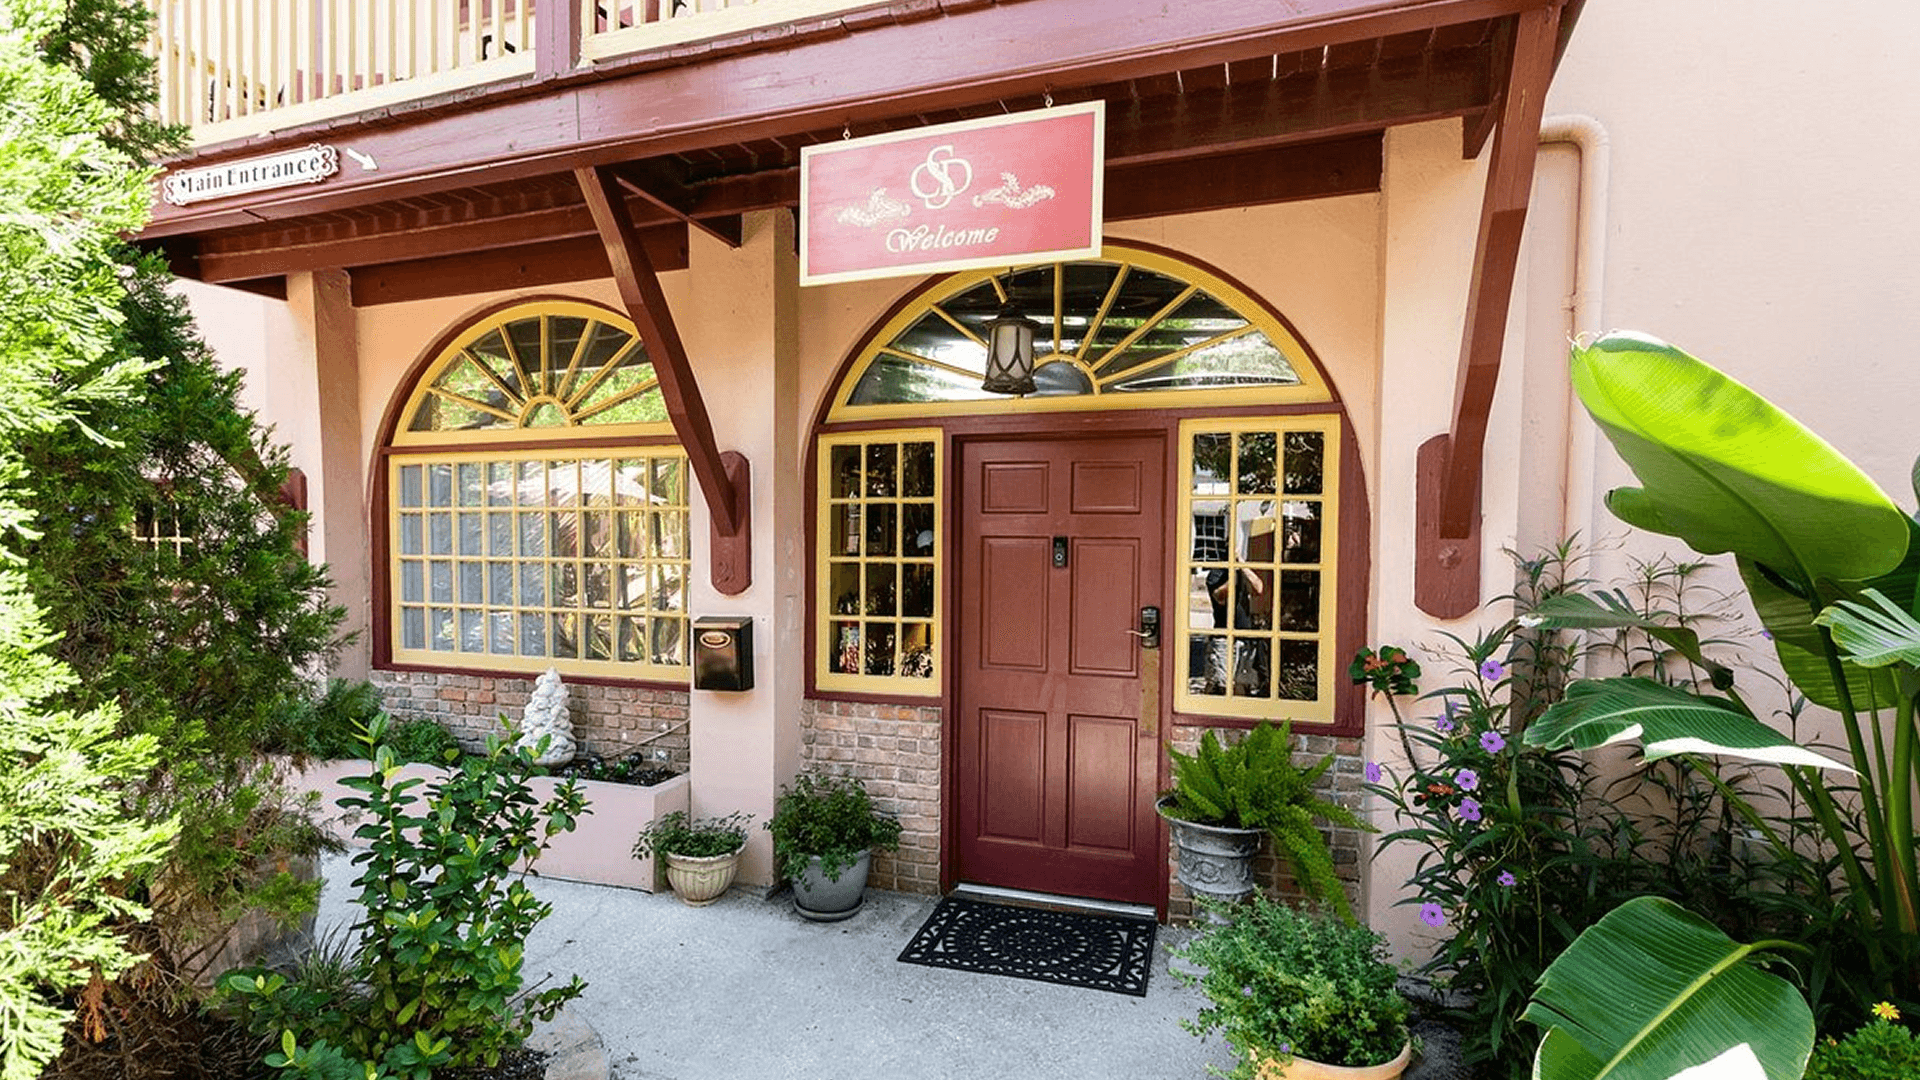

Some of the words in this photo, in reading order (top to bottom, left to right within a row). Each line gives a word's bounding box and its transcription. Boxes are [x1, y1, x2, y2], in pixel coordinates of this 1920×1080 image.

[179, 172, 223, 193] Main
[227, 157, 320, 186] Entrance
[886, 224, 1000, 253] Welcome
